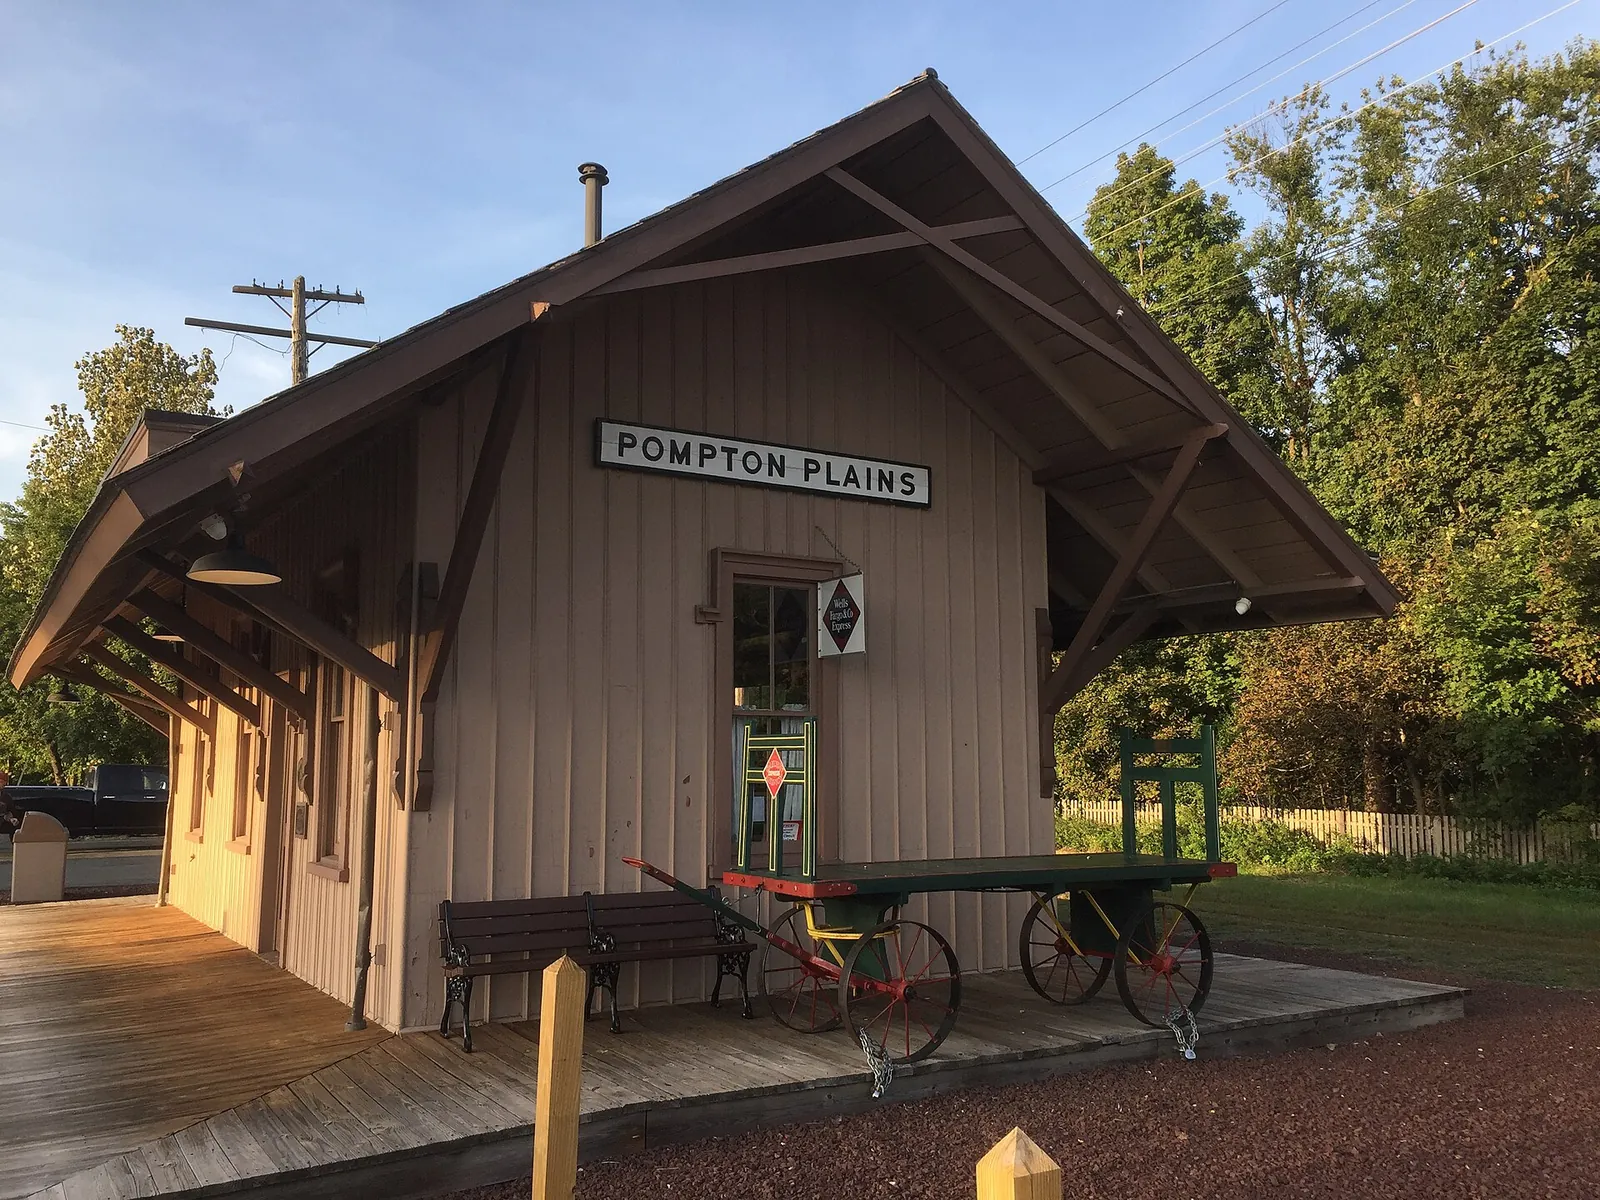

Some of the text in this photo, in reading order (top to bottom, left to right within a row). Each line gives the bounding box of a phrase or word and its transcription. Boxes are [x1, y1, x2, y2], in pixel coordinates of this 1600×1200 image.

[618, 431, 916, 496] POMPTON PLAINS
[833, 598, 848, 608] Wells
[831, 621, 851, 632] Express
